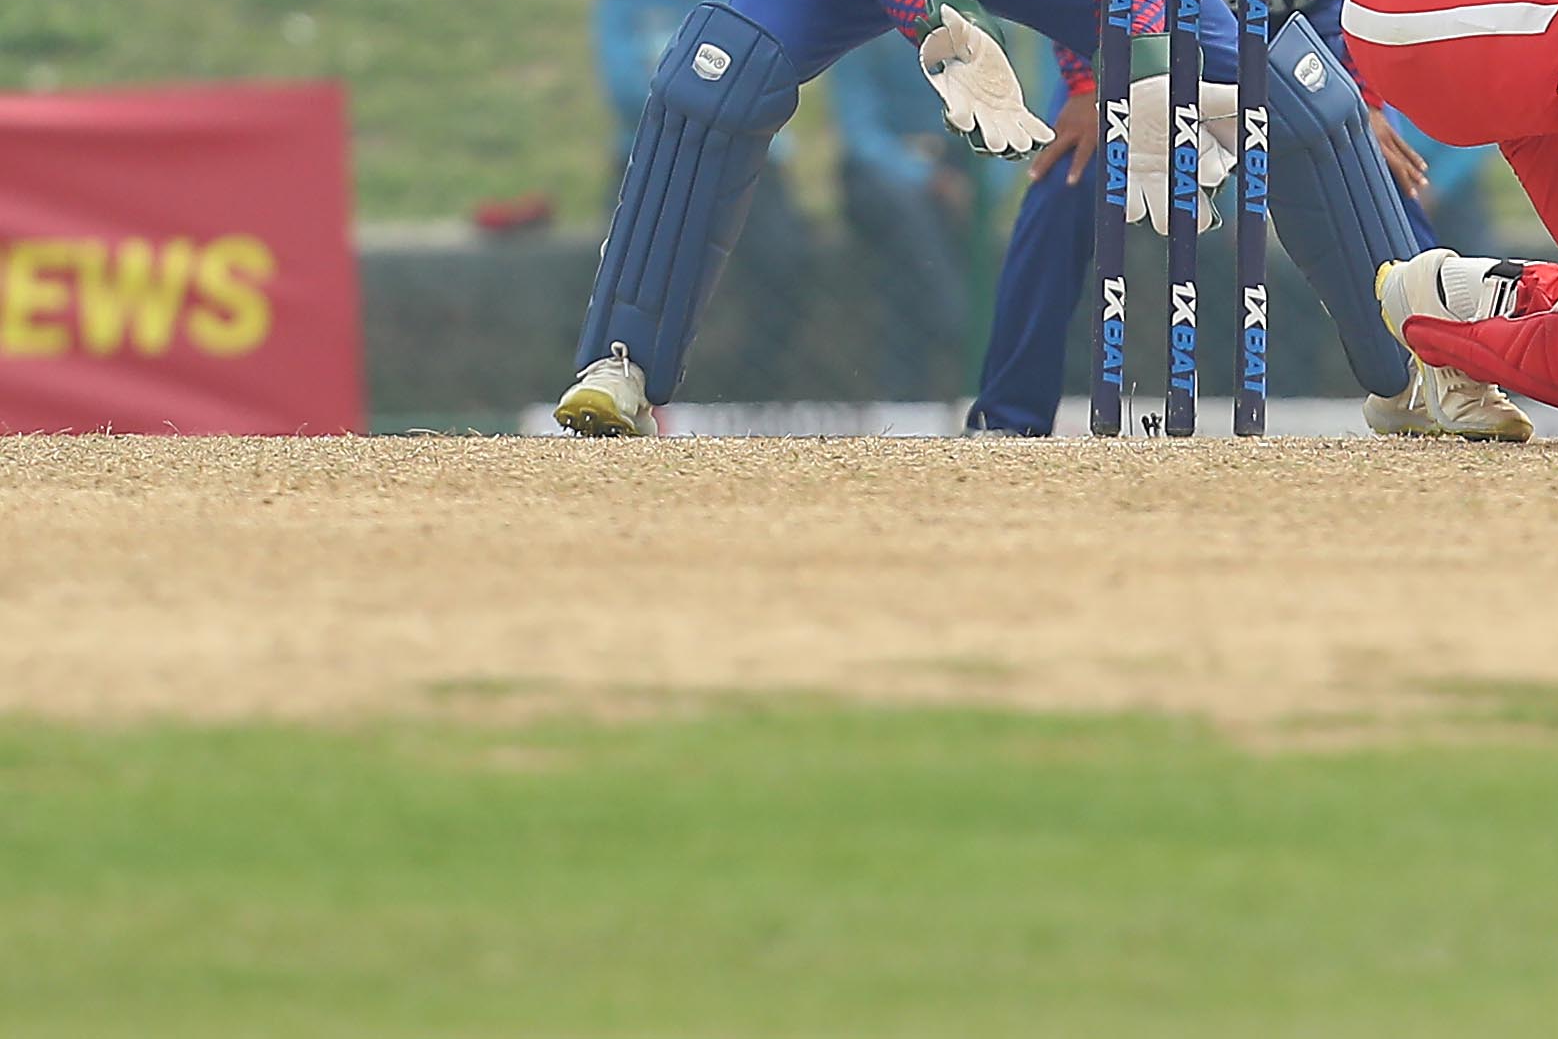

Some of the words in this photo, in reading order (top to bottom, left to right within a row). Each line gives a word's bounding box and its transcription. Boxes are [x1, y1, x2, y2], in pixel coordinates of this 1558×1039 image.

[1106, 98, 1130, 209] 1XBAT
[1174, 103, 1199, 220] 1XBAT
[1245, 107, 1269, 221] 1XBAT
[1103, 276, 1126, 392] 1XBAT
[1171, 281, 1197, 398] 1XBAT
[1244, 284, 1267, 400] 1XBAT
